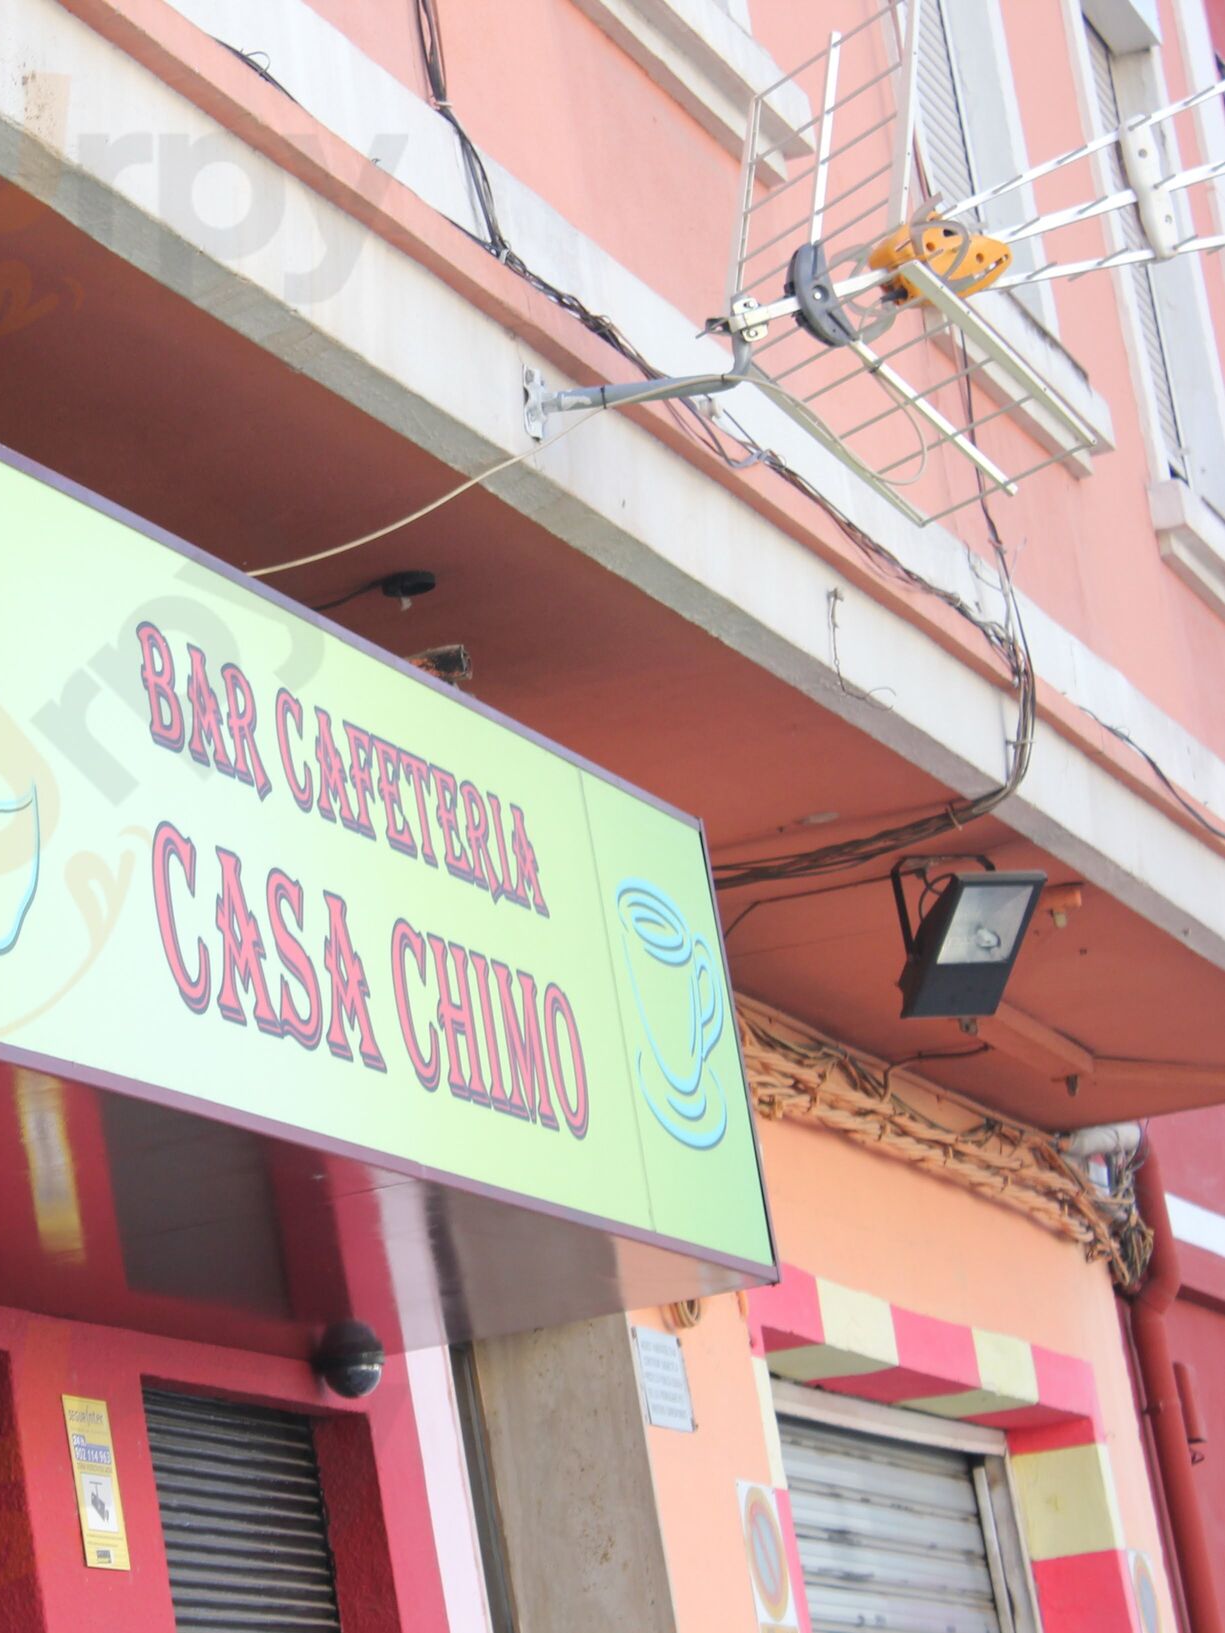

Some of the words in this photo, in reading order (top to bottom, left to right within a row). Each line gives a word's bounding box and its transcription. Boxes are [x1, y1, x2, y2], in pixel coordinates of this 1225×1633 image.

[136, 621, 272, 801] BAR
[276, 687, 550, 918] CAFETERIA
[152, 821, 387, 1073] CASA
[391, 917, 589, 1140] CHIMO
